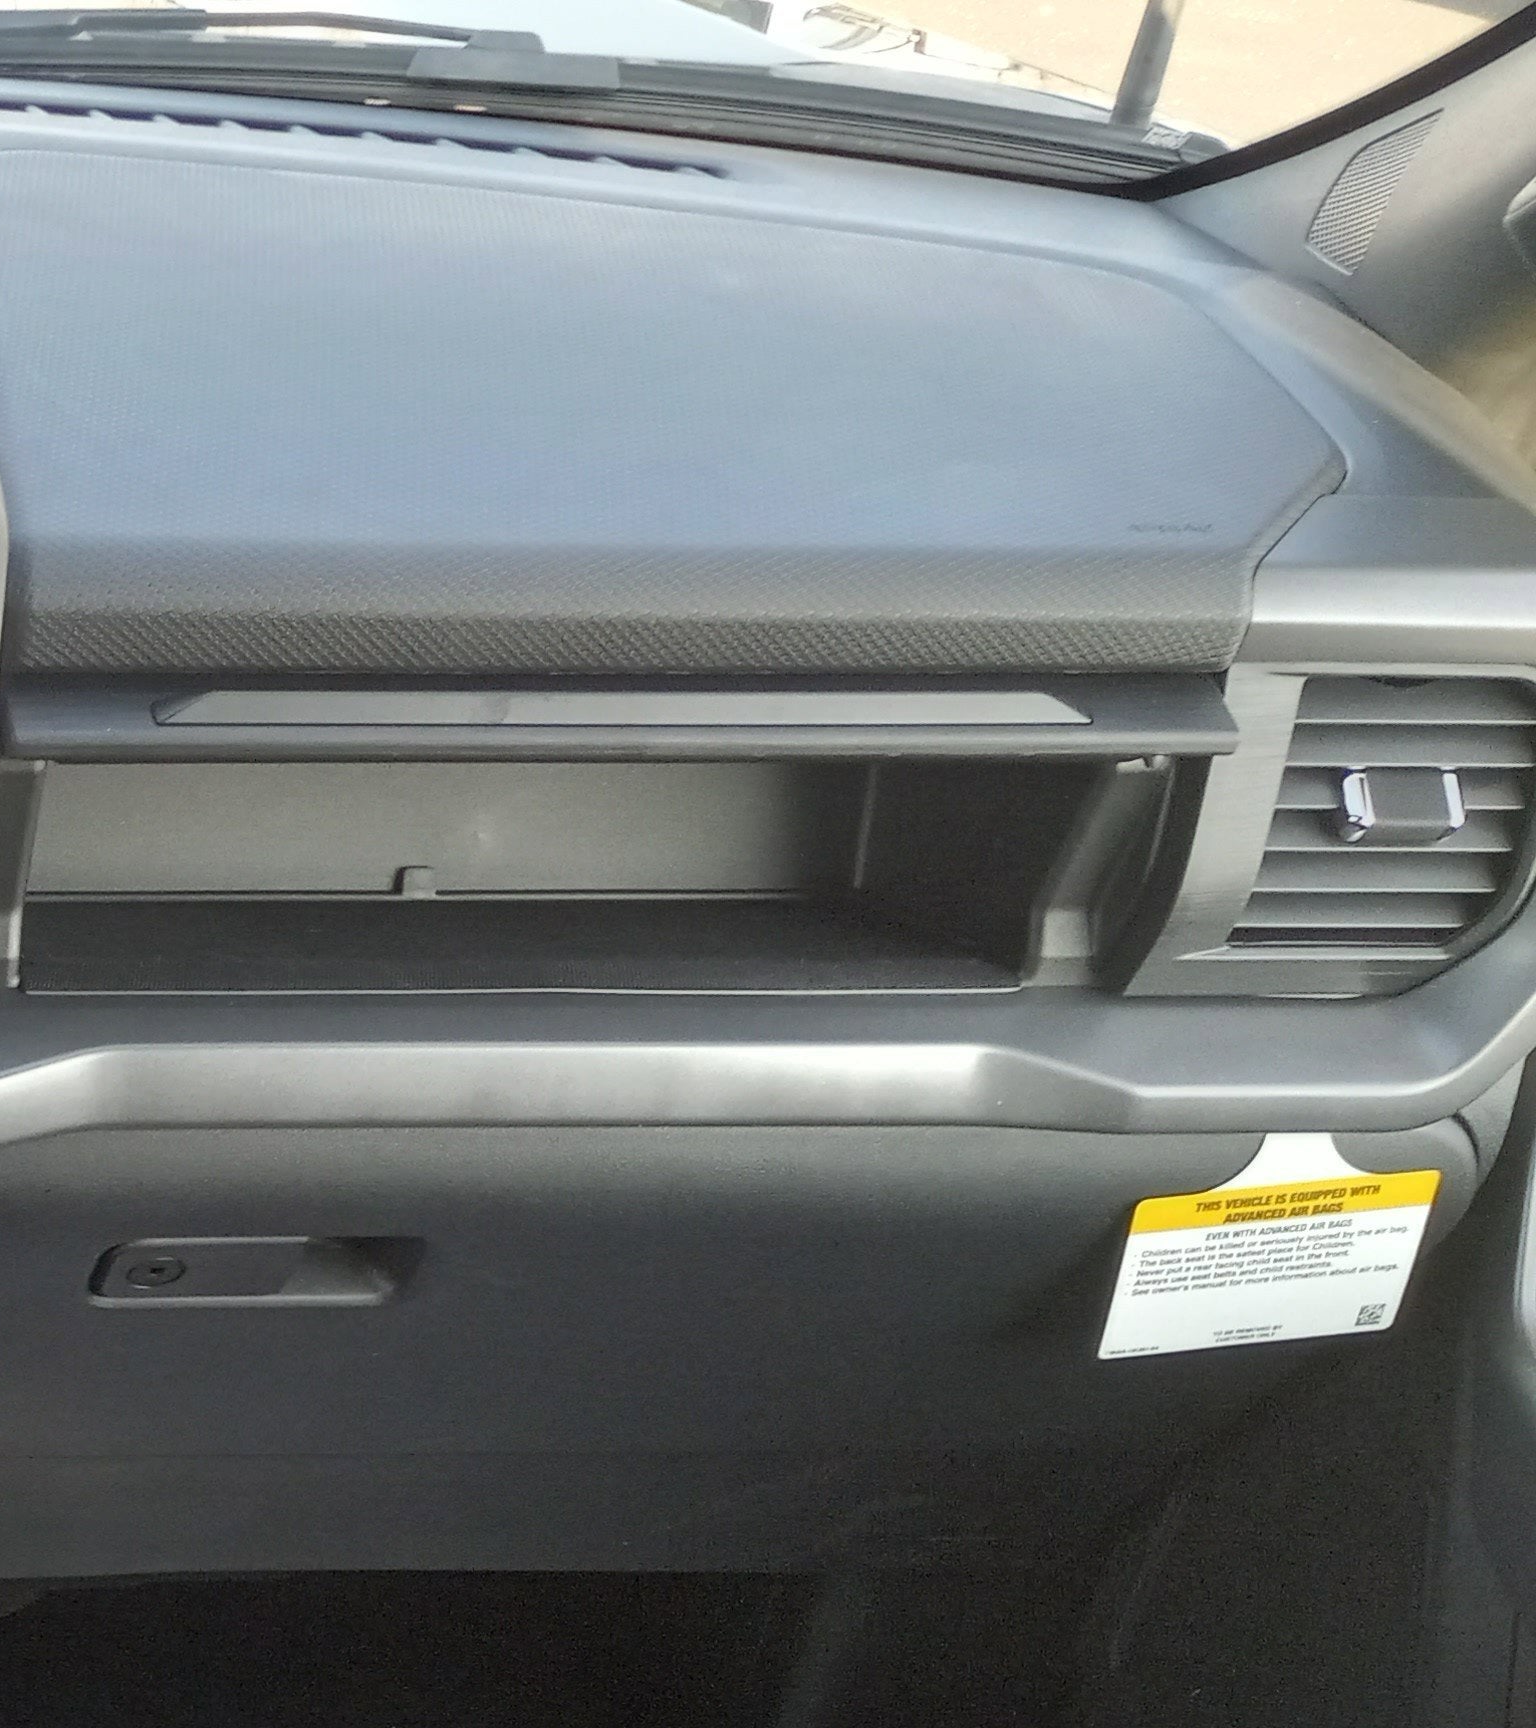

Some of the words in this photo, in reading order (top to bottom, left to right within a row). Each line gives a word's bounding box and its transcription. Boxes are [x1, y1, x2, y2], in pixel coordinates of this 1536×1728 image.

[1195, 1201, 1221, 1213] THIS
[1225, 1195, 1271, 1209] VEHICLE
[1275, 1193, 1287, 1205] IS
[1289, 1188, 1347, 1204] EQUIPPED
[1350, 1185, 1381, 1197] WITH
[1223, 1210, 1285, 1224] ADVANCED
[1288, 1206, 1310, 1218] AIR
[1311, 1202, 1344, 1215] BAGS
[1205, 1230, 1230, 1241] EVEN
[1232, 1228, 1257, 1238] WITH
[1258, 1223, 1307, 1236] ADVANCED
[1308, 1221, 1326, 1231] AIR
[1328, 1218, 1353, 1229] BAGS
[1141, 1248, 1183, 1258] Children
[1204, 1244, 1217, 1252] be
[1218, 1241, 1245, 1250] killed
[1260, 1235, 1304, 1247] seriously
[1306, 1232, 1340, 1243] injured
[1342, 1231, 1354, 1240] by
[1357, 1228, 1373, 1237] the
[1374, 1227, 1387, 1235] air
[1136, 1268, 1165, 1277] Never
[1166, 1266, 1183, 1275] put
[1215, 1260, 1244, 1270] facing
[1246, 1257, 1271, 1267] child
[1273, 1255, 1293, 1263] seat
[1307, 1252, 1322, 1260] the
[1139, 1259, 1157, 1268] The
[1159, 1256, 1183, 1265] back
[1185, 1255, 1205, 1263] seat
[1218, 1252, 1234, 1260] the
[1267, 1246, 1293, 1256] place
[1296, 1243, 1310, 1252] for
[1131, 1288, 1149, 1297] See
[1151, 1284, 1189, 1295] owner's
[1191, 1280, 1227, 1290] manual
[1228, 1278, 1242, 1287] for
[1244, 1277, 1269, 1285] more
[1271, 1270, 1327, 1283] information
[1329, 1267, 1357, 1277] about
[1358, 1265, 1372, 1274] air
[1133, 1277, 1169, 1287] Always
[1190, 1273, 1211, 1281] seat
[1213, 1270, 1237, 1278] belts
[1239, 1267, 1257, 1275] and
[1259, 1265, 1283, 1274] child
